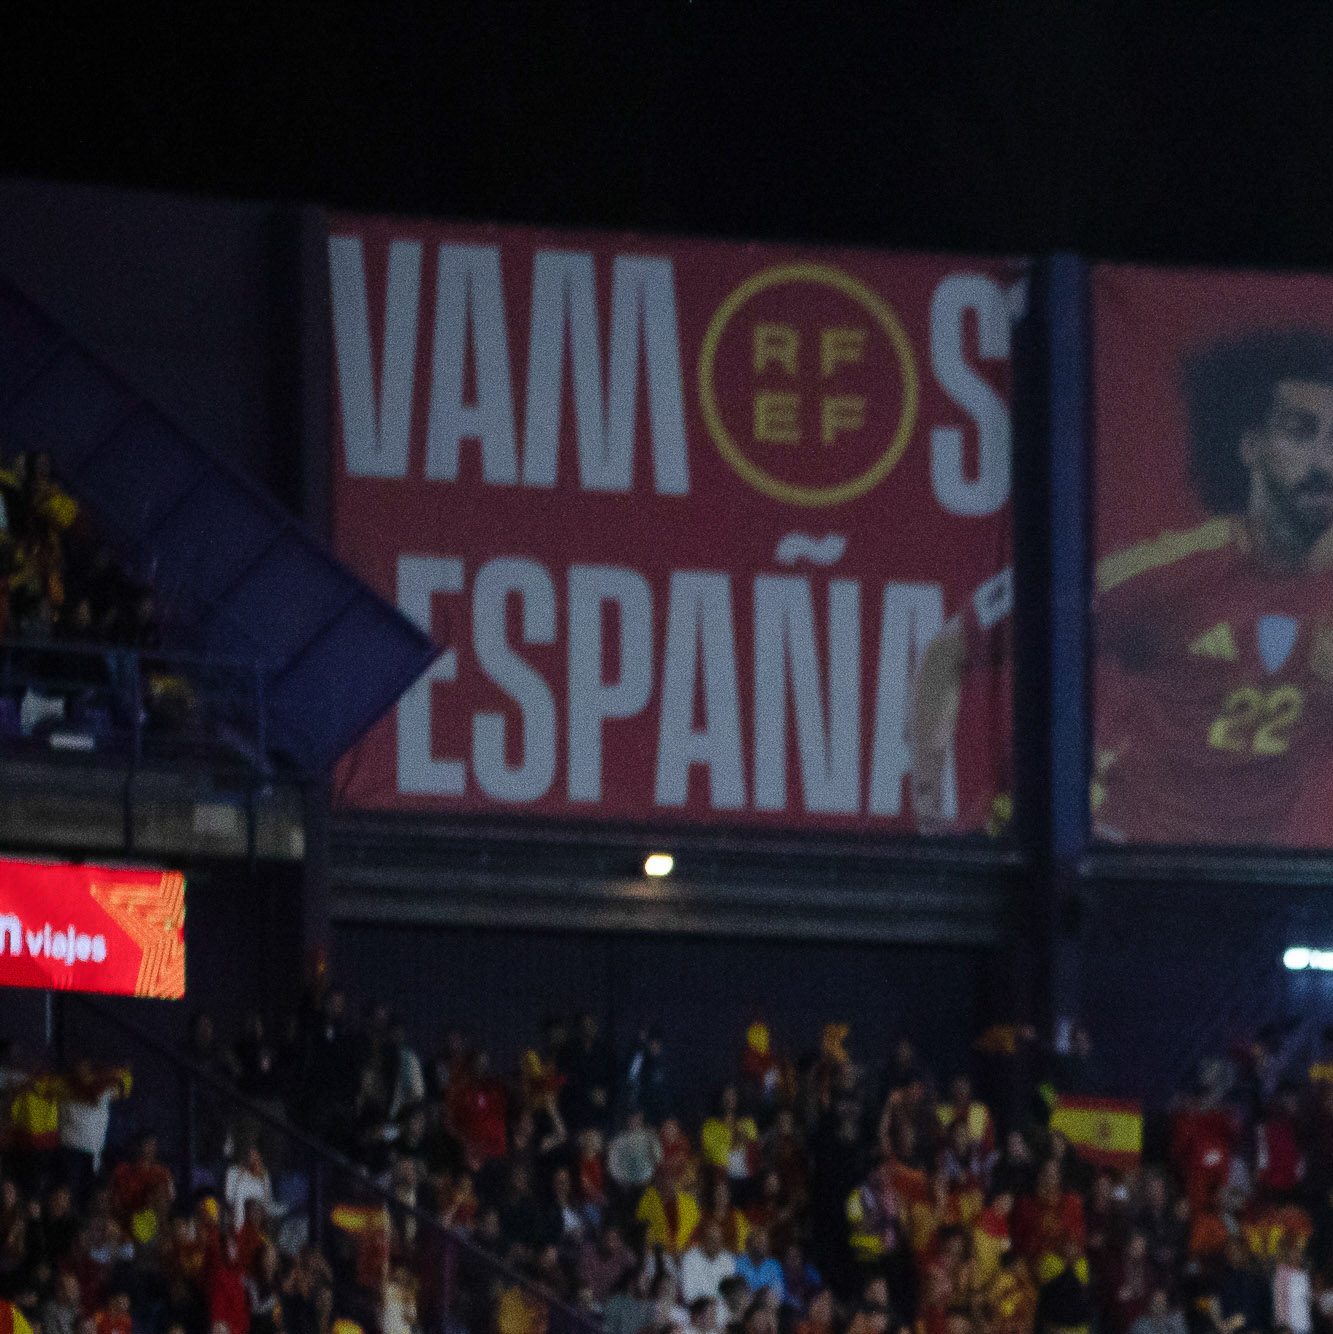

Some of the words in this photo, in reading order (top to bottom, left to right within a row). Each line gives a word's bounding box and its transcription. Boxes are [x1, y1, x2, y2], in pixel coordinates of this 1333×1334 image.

[397, 533, 958, 820] ESPAÑA
[1208, 684, 1304, 756] 22
[26, 921, 107, 967] viajes
